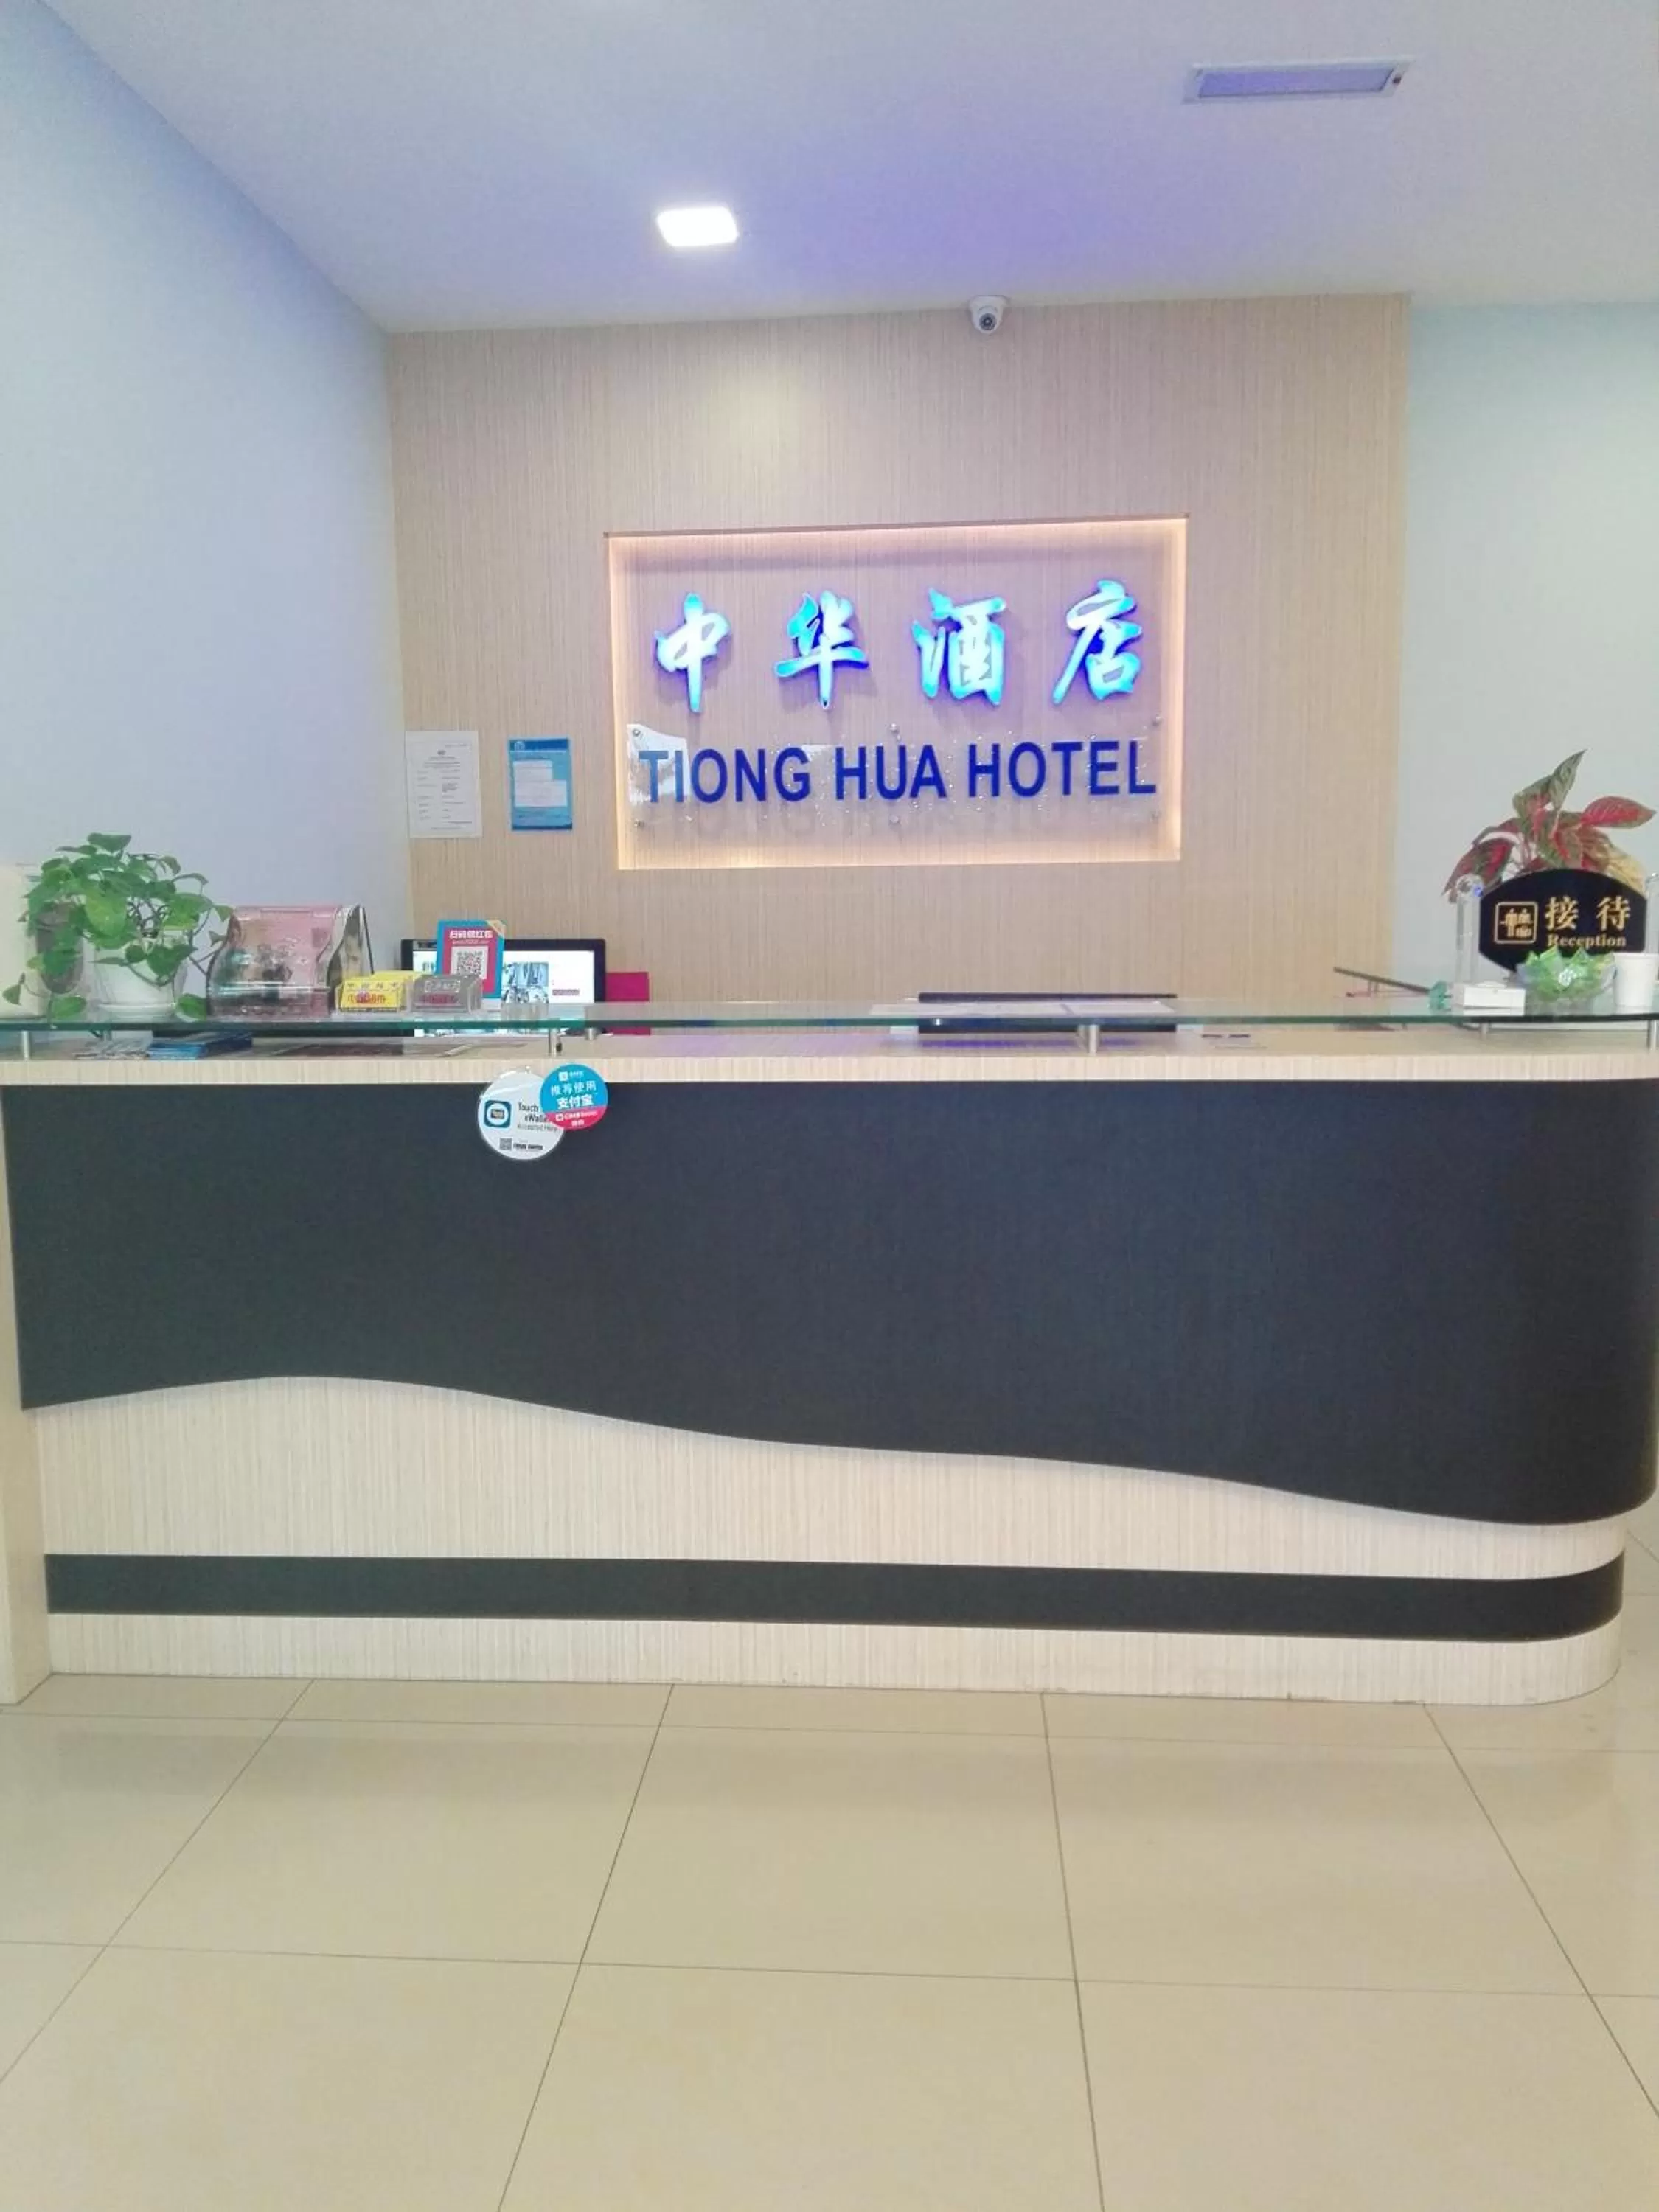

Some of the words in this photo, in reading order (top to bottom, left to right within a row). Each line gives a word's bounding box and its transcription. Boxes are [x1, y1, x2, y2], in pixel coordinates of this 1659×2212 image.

[654, 579, 1144, 712] 中华酒店
[639, 747, 810, 803] TIONG
[835, 744, 947, 800] HUA
[968, 740, 1156, 797] HOTEL
[1545, 895, 1631, 931] 接待
[1547, 933, 1627, 950] Reception
[550, 1080, 597, 1096] 推荐使用
[557, 1094, 594, 1109] 支付宝
